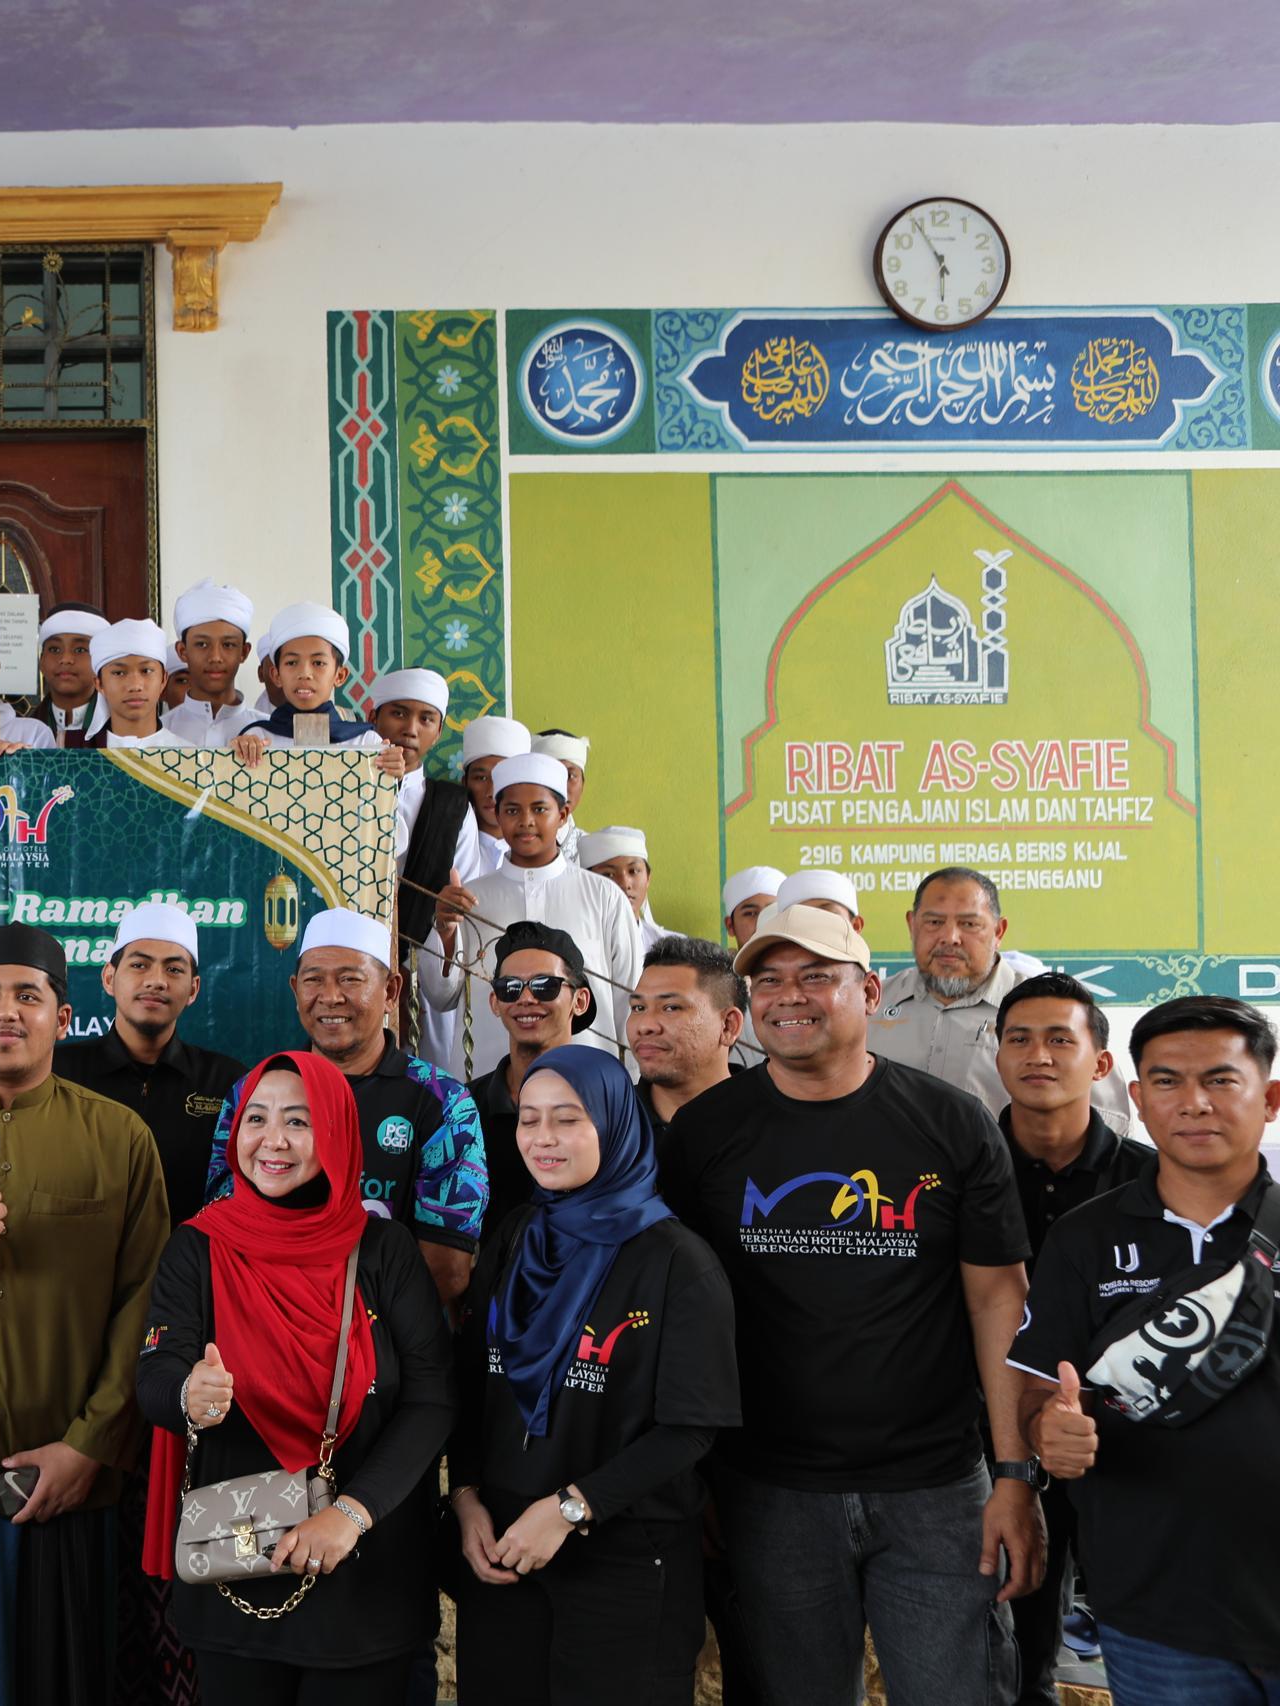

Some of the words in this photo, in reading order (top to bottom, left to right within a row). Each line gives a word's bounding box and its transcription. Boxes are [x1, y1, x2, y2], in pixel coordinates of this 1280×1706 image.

[909, 217, 925, 234] 11
[929, 210, 951, 228] 12
[960, 217, 968, 234] 1
[894, 233, 913, 250] 10
[975, 233, 990, 250] 2
[886, 256, 901, 273] 9
[982, 257, 996, 274] 3
[893, 280, 908, 297] 8
[974, 281, 990, 297] 4
[912, 298, 927, 314] 7
[934, 305, 949, 320] 6
[958, 298, 973, 315] 5
[890, 693, 931, 704] RIBAT
[785, 741, 904, 794] RIBAT
[918, 739, 1129, 793] AS-SYAFIE
[770, 799, 836, 825] PUSAT
[841, 798, 959, 824] PENGAJIAN
[965, 797, 1030, 824] ISLAM
[1035, 797, 1077, 823] DAN
[1079, 797, 1154, 822] TAHFIZ
[800, 845, 842, 866] 2916
[851, 843, 935, 864] KAMPUNG
[939, 842, 1012, 863] MERAGA
[1015, 841, 1067, 862] BERIS
[1073, 841, 1128, 861] KIJAL
[386, 1124, 407, 1138] PC
[382, 1137, 408, 1148] OGD
[740, 1234, 809, 1245] PERSATUAN
[811, 1236, 854, 1246] HOTEL
[855, 1238, 918, 1247] MALAYSIA
[796, 1229, 860, 1237] ASSOCIATION
[882, 1231, 919, 1239] HOTELS
[742, 1243, 842, 1255] TERENGGANU
[846, 1246, 917, 1257] CHAPTER
[575, 1360, 610, 1373] HOTELS
[564, 1376, 605, 1393] APTER
